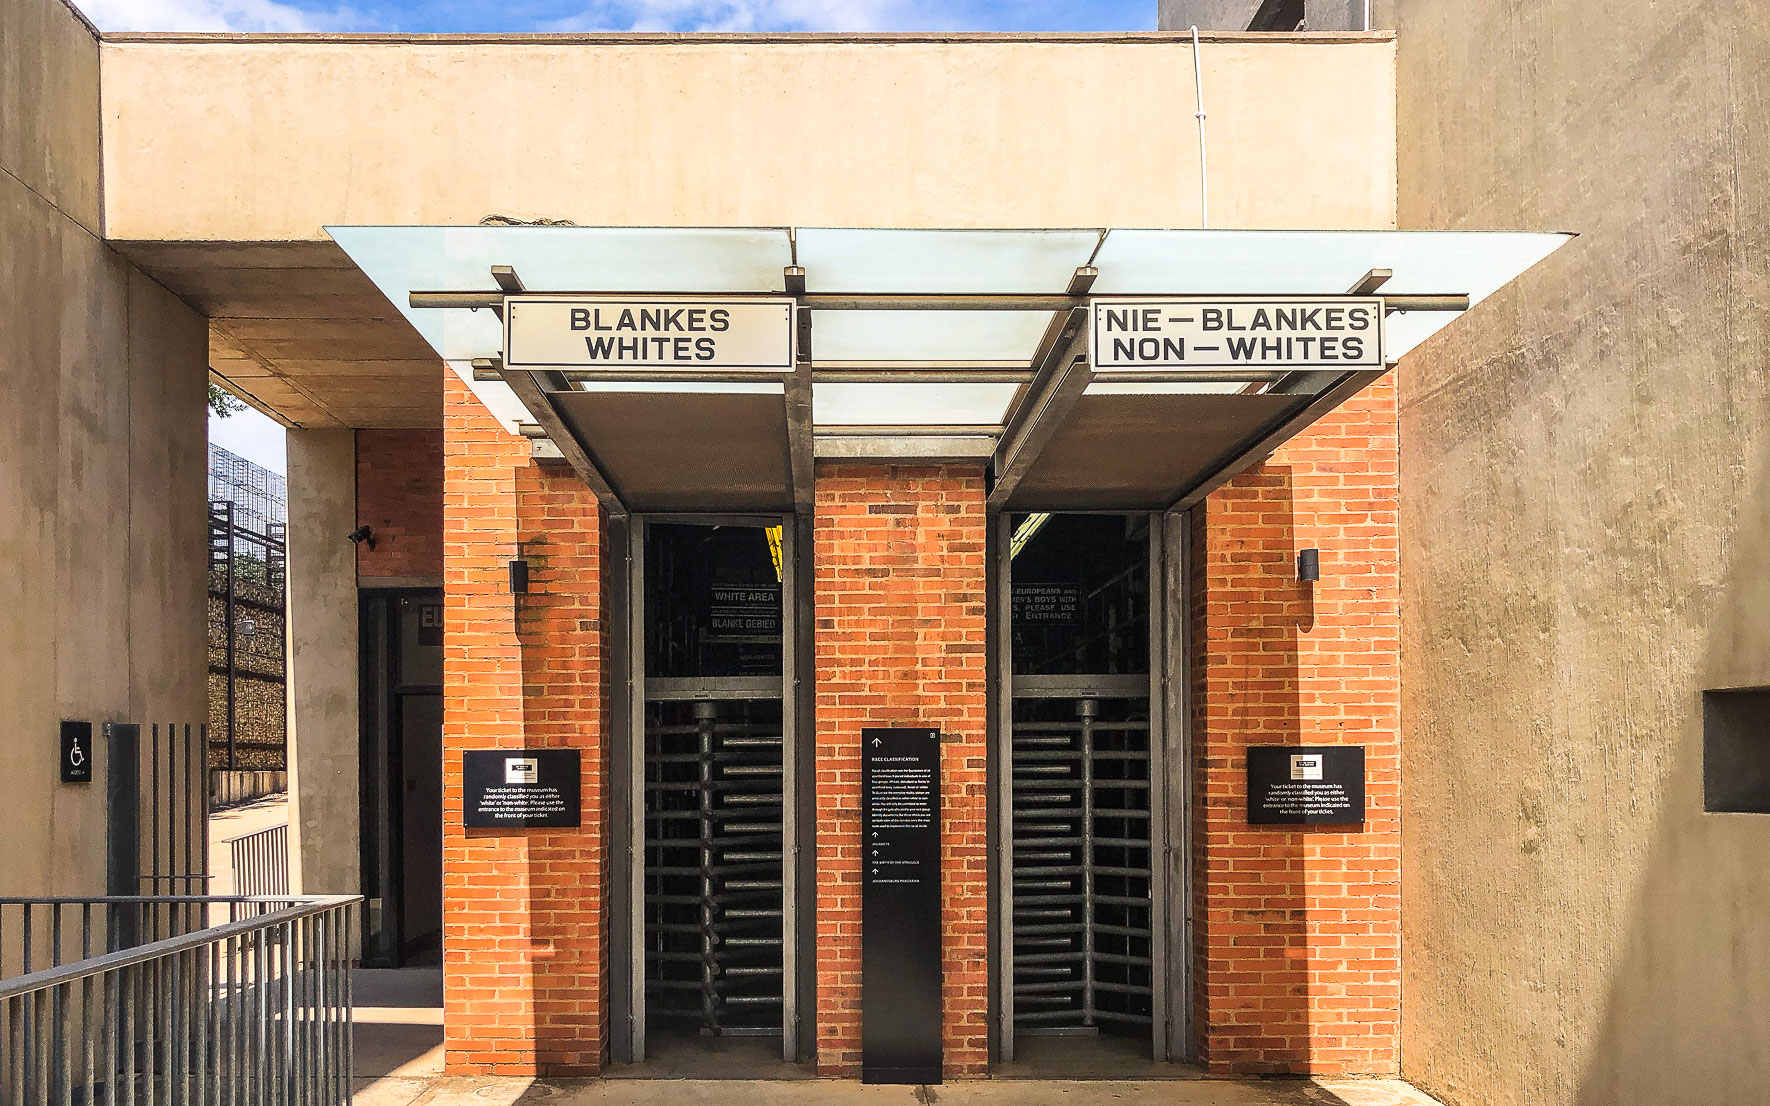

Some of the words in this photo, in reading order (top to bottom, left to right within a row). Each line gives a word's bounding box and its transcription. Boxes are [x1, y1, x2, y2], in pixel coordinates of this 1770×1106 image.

[570, 308, 730, 332] BLANKES
[585, 337, 716, 361] WHITES
[715, 592, 746, 601] WHITE
[748, 592, 774, 602] AREA
[1025, 611, 1073, 620] ENTRANCE
[711, 618, 744, 629] BLANKE
[745, 619, 776, 630] GEBIED
